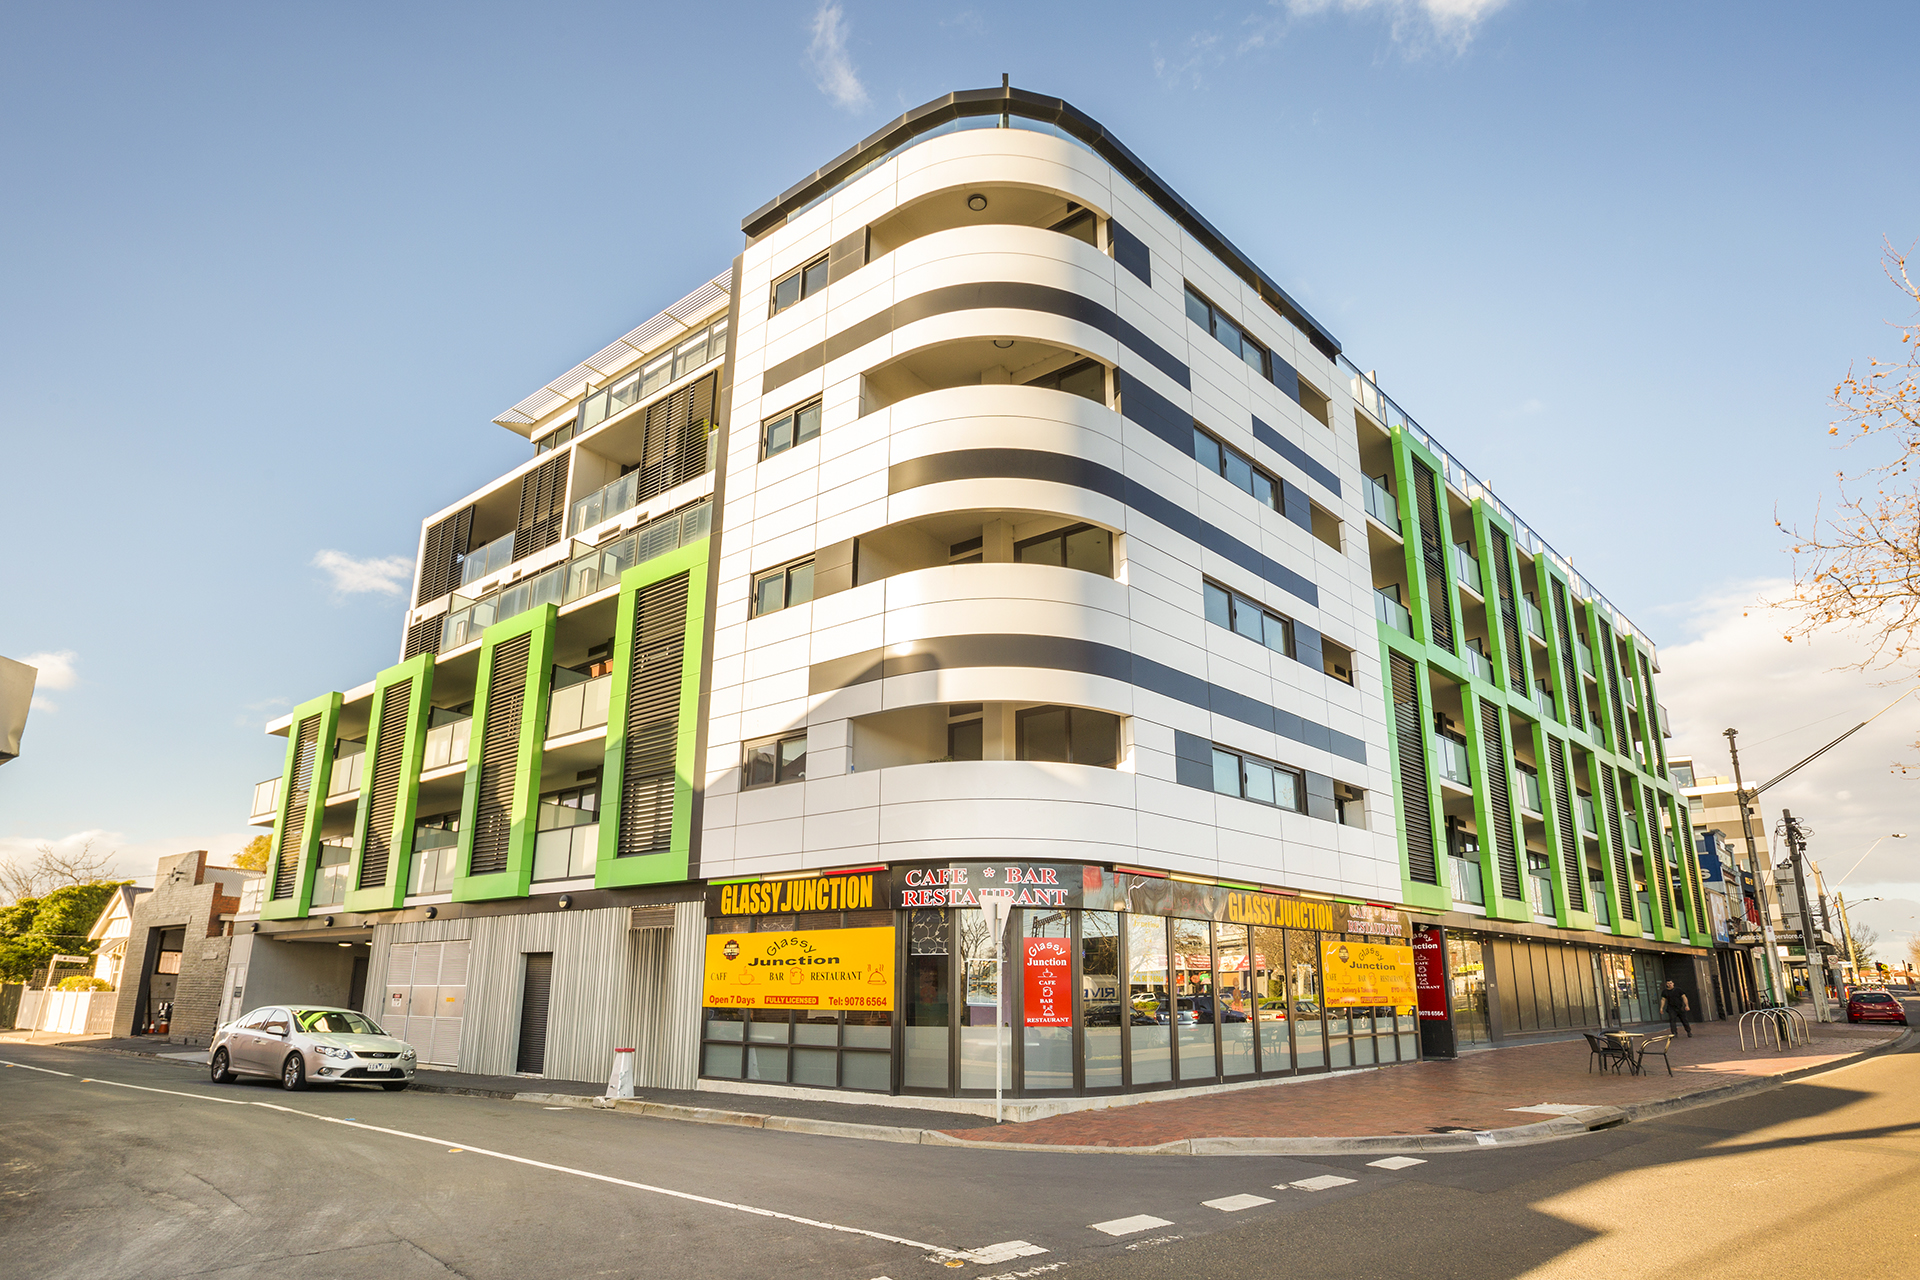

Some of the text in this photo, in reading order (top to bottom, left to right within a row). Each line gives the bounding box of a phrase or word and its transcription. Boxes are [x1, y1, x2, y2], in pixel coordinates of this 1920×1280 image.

[905, 866, 1059, 887] CAFE BAR
[721, 875, 873, 915] GLASSY JUNCTION
[1228, 892, 1334, 931] GLASSY JUNCTION
[1349, 904, 1398, 922] CAFE BAR
[1347, 920, 1402, 936] RESTAURANT
[1412, 933, 1433, 942] assy
[767, 937, 817, 956] Glassy
[1029, 942, 1066, 957] Glassy
[1358, 947, 1384, 961] Glassy
[748, 956, 840, 967] Junction
[1027, 958, 1067, 966] Junction
[1349, 961, 1396, 970] Junction
[710, 971, 862, 981] CAFE BAR RESTAURANT
[1325, 973, 1337, 981] CAFE
[709, 995, 755, 1006] Open 7 Days
[828, 996, 887, 1006] Tel: 9078 6564
[1327, 997, 1340, 1005] Open
